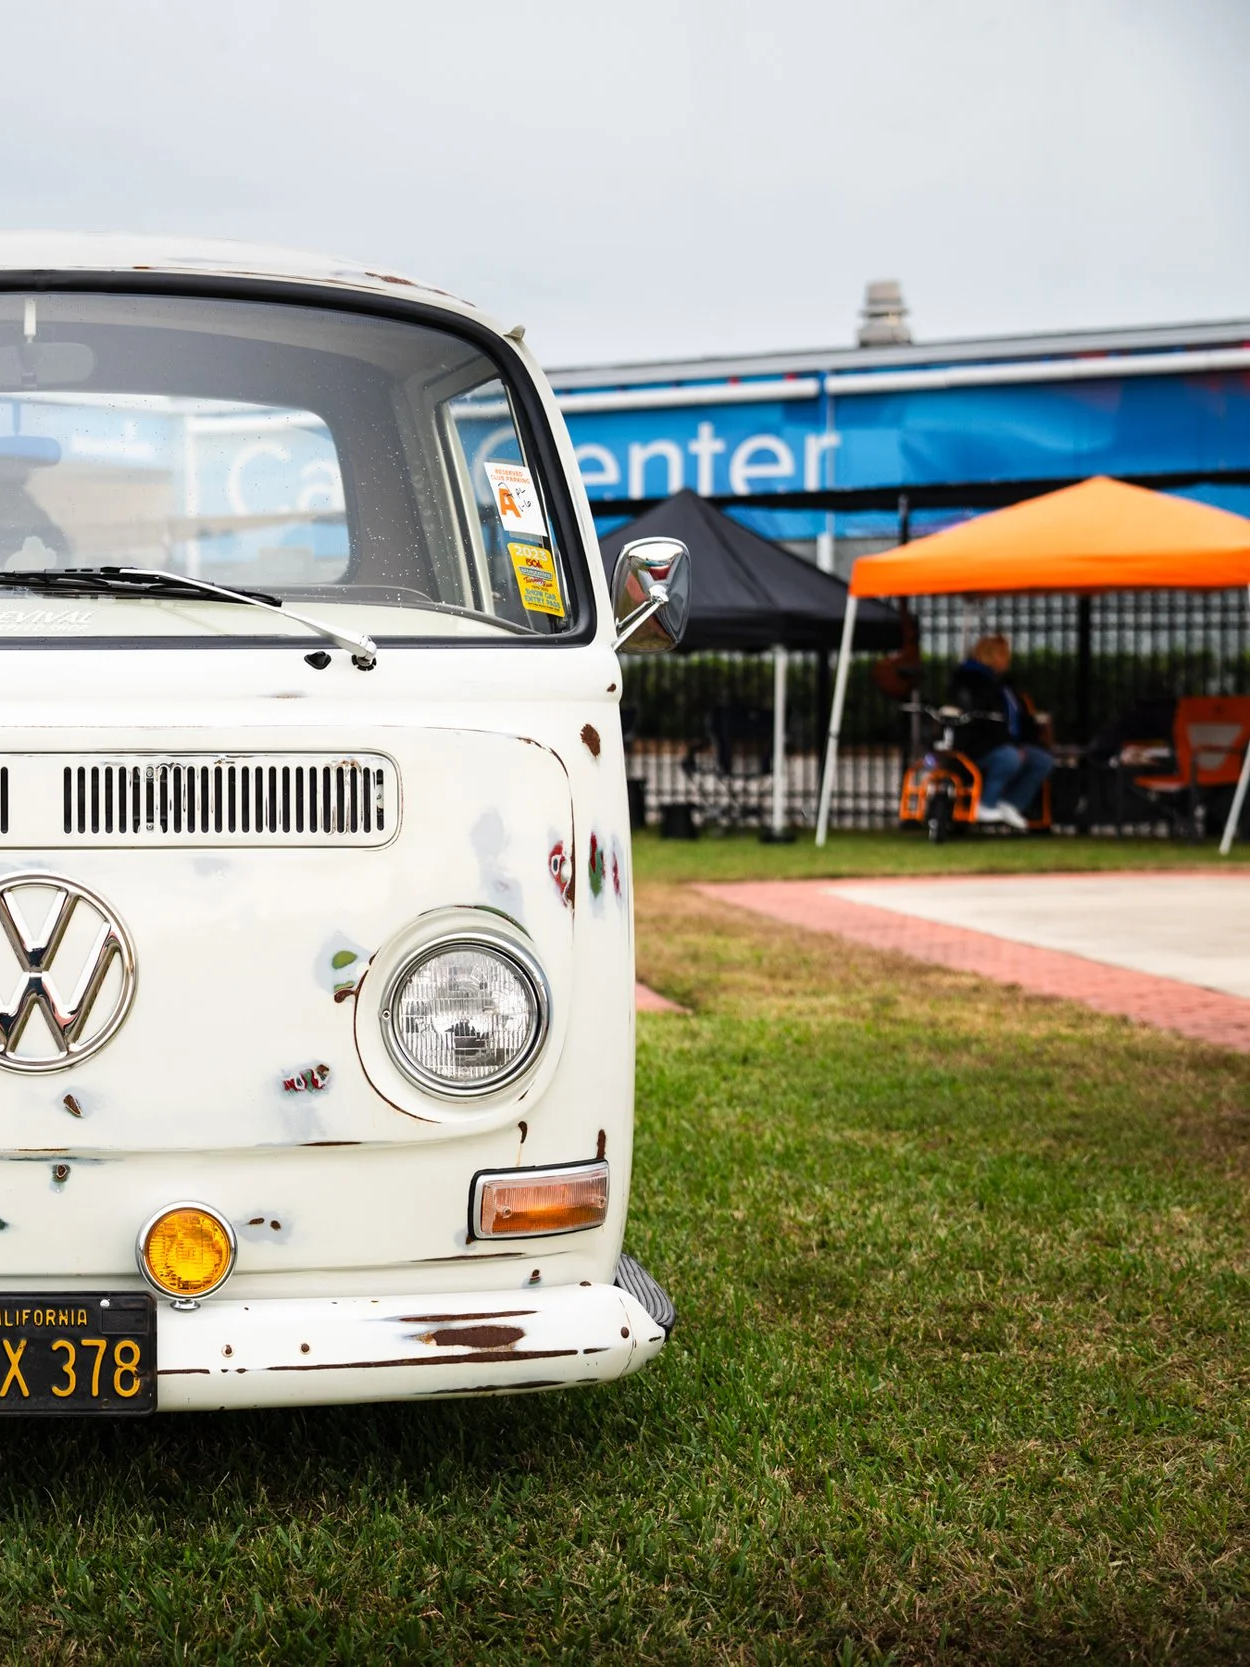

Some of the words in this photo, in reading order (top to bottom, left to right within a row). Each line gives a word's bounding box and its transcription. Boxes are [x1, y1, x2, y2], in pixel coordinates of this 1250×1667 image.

[495, 468, 523, 477] RESERVED
[505, 476, 531, 485] PARKING
[498, 487, 522, 518] A
[513, 544, 548, 562] 2023
[525, 588, 544, 598] SHOW
[524, 595, 545, 605] ENTRY
[51, 1339, 142, 1398] 378
